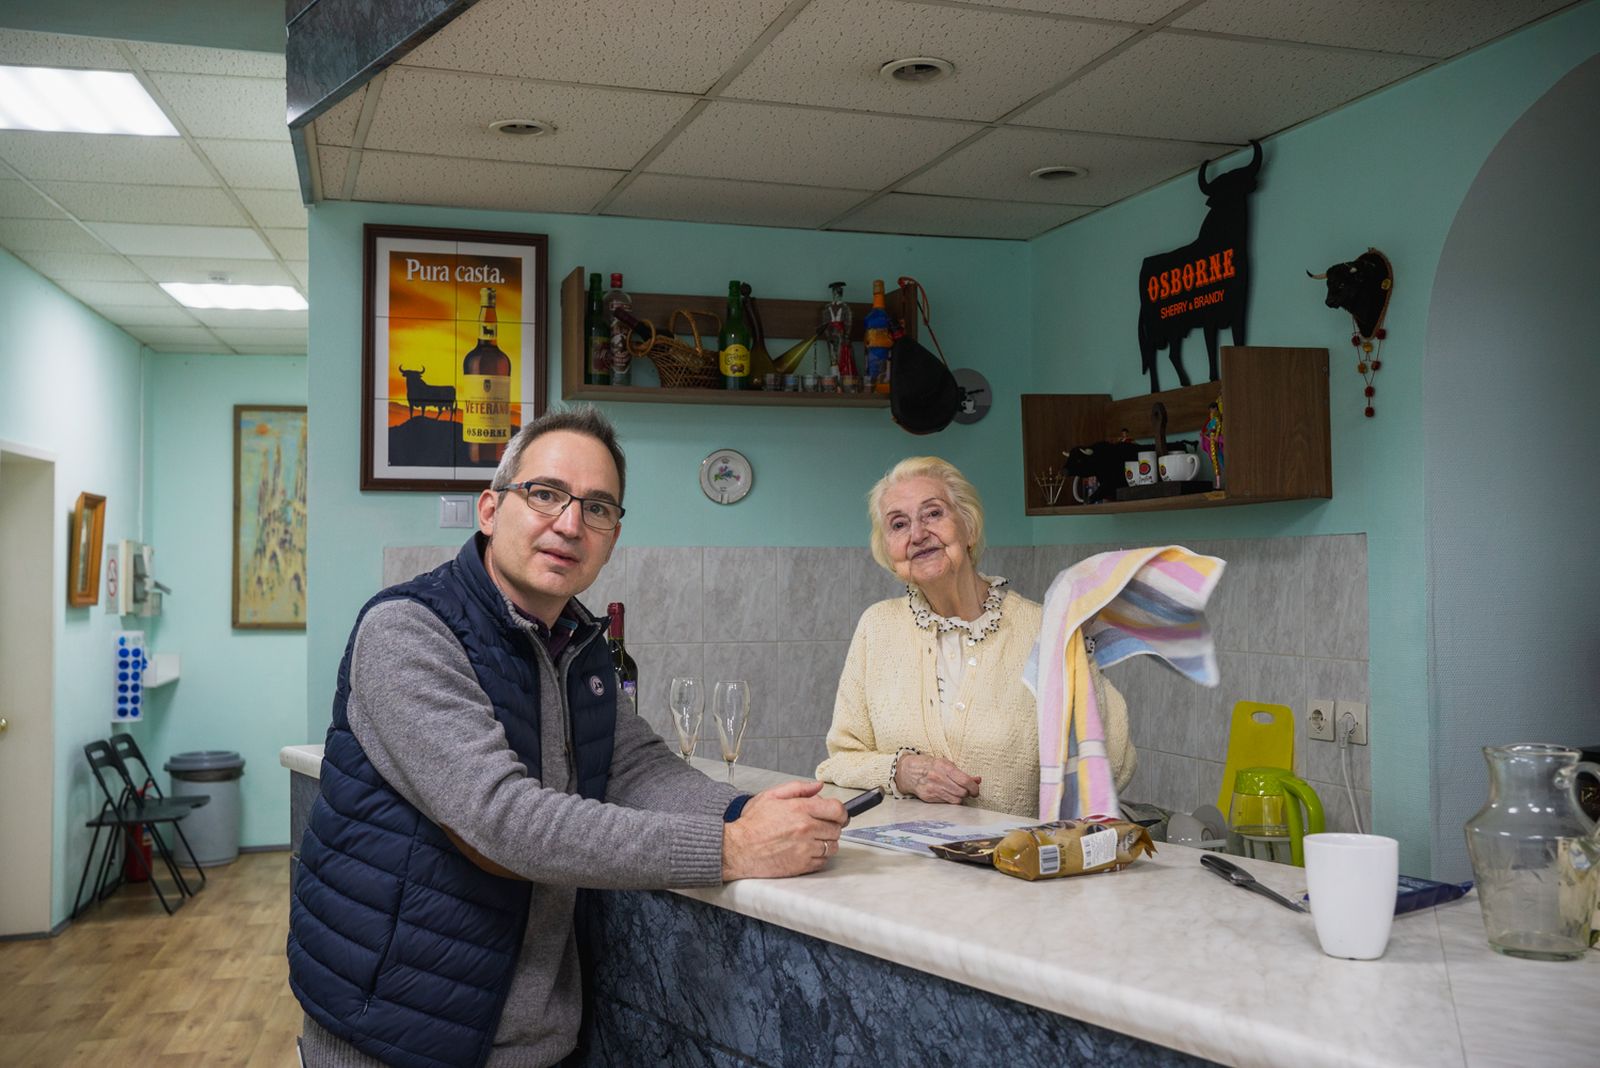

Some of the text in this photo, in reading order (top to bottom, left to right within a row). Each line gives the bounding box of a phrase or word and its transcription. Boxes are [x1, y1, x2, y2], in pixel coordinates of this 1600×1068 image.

[406, 258, 505, 284] Pura casta.
[1148, 248, 1235, 302] OSBORNE
[1160, 301, 1188, 319] SHERRY
[1193, 289, 1225, 309] BRANDY
